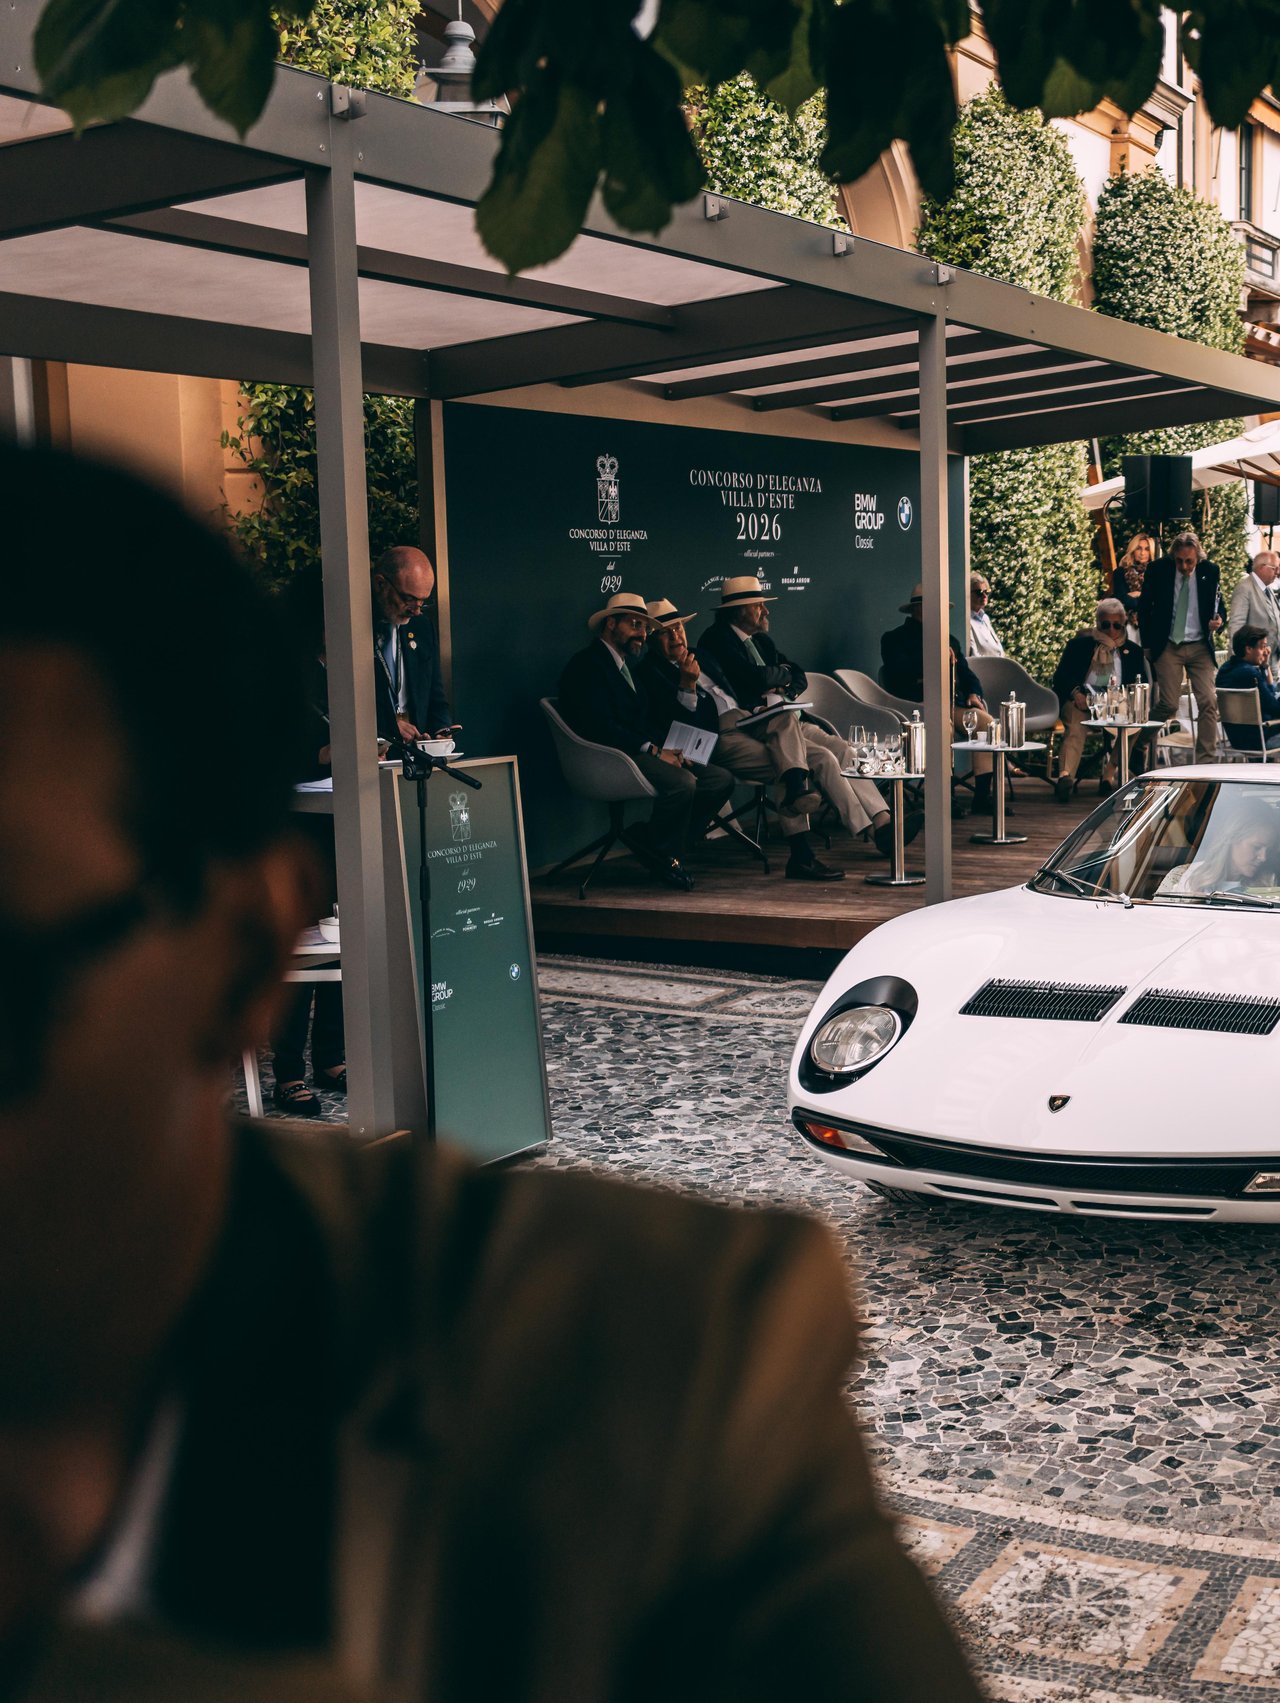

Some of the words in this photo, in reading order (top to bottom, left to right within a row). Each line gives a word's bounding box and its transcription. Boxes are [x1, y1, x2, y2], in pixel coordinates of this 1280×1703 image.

[690, 469, 753, 488] CONCORSO
[757, 474, 822, 493] D'ELEGANZA
[721, 490, 754, 508] VILLA
[758, 492, 795, 509] D'ESTE
[854, 493, 877, 511] BMW
[736, 512, 781, 541] 2026
[855, 512, 885, 530] GROUP
[569, 528, 607, 539] CONCORSO
[609, 529, 648, 540] D'ELEGANZA
[855, 535, 874, 549] Classic
[589, 541, 608, 551] VILLA
[610, 541, 631, 551] D'ESTE
[600, 575, 622, 593] 1929
[427, 846, 462, 859] CONCORSO
[445, 855, 463, 864] VILLA
[457, 877, 476, 894] 1929
[431, 988, 453, 1002] GROUP
